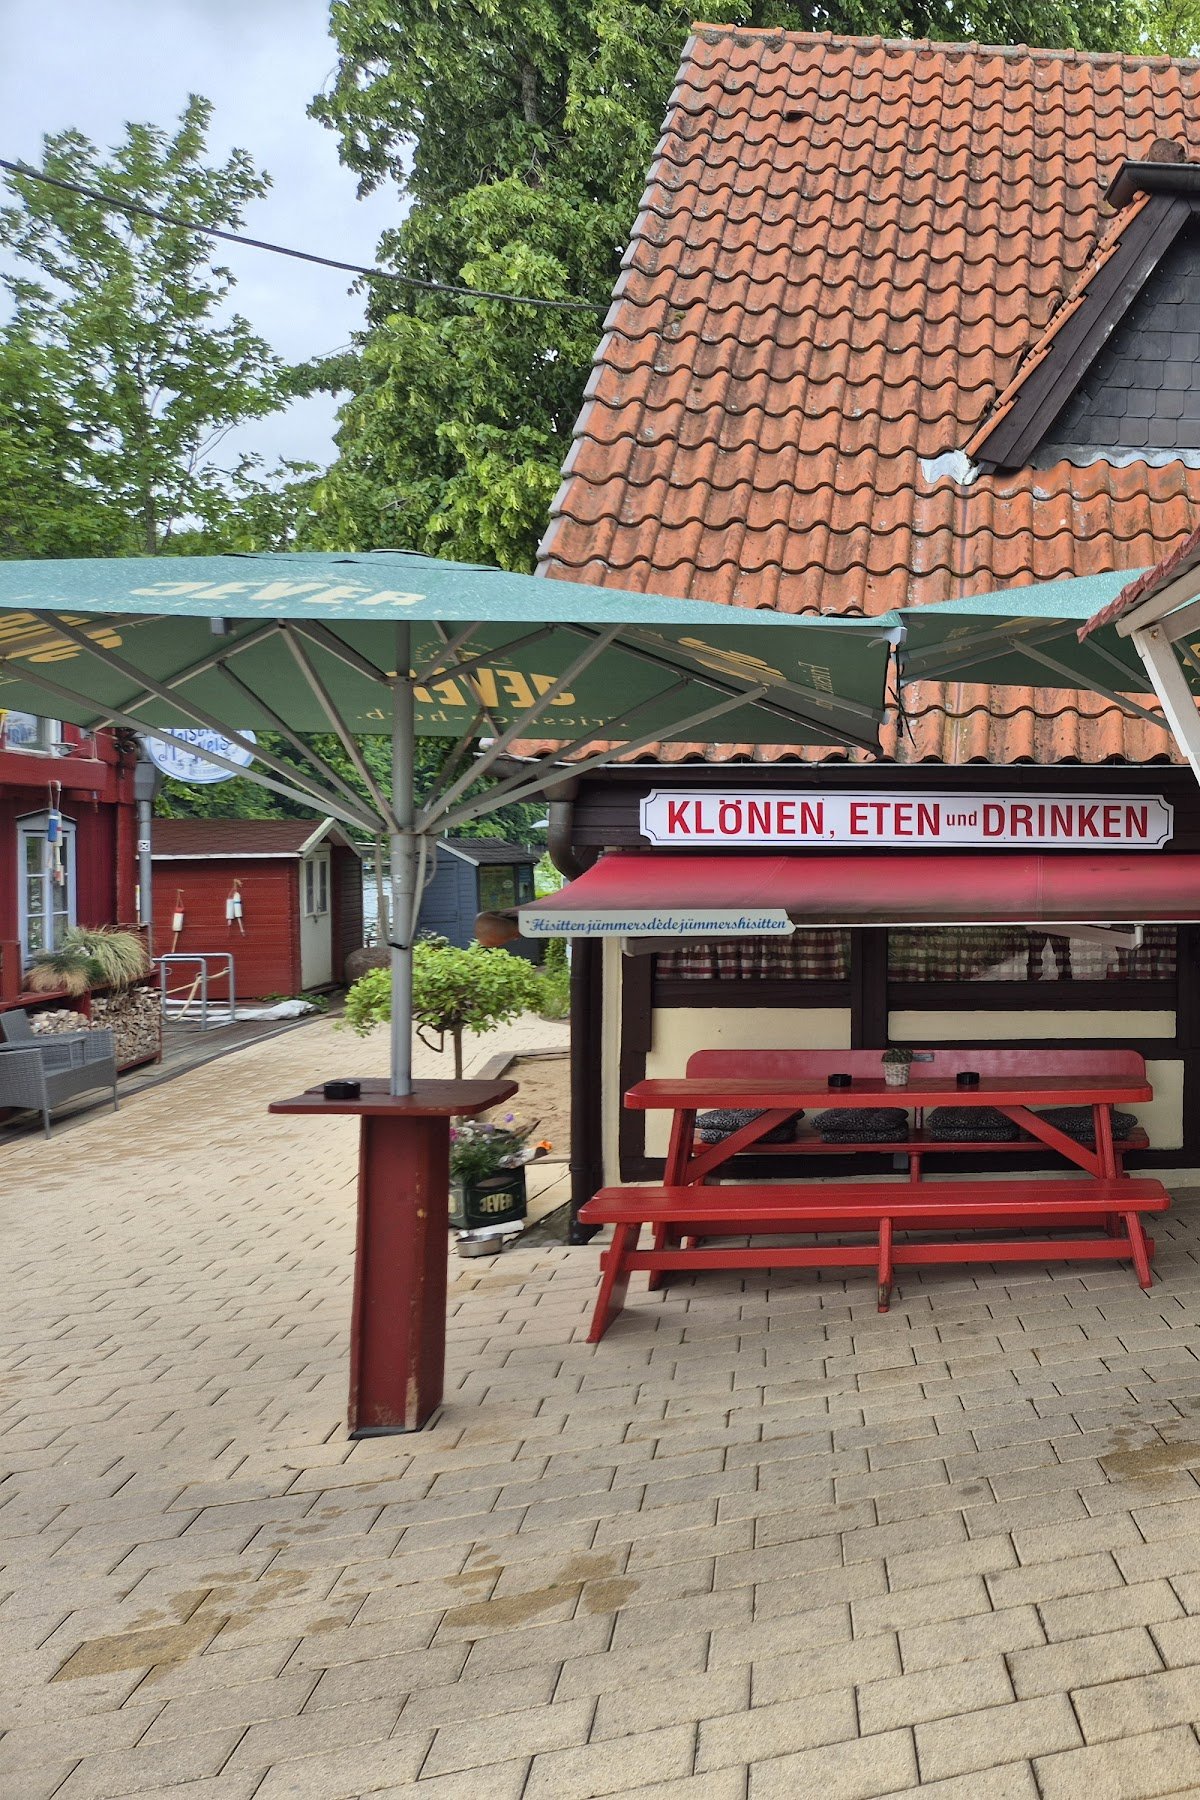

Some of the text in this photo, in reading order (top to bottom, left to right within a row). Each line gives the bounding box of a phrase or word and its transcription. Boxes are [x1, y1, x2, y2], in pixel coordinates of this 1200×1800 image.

[129, 581, 427, 606] JEVER
[667, 799, 1149, 839] KLÖNEN, ETEN und DRINKEN
